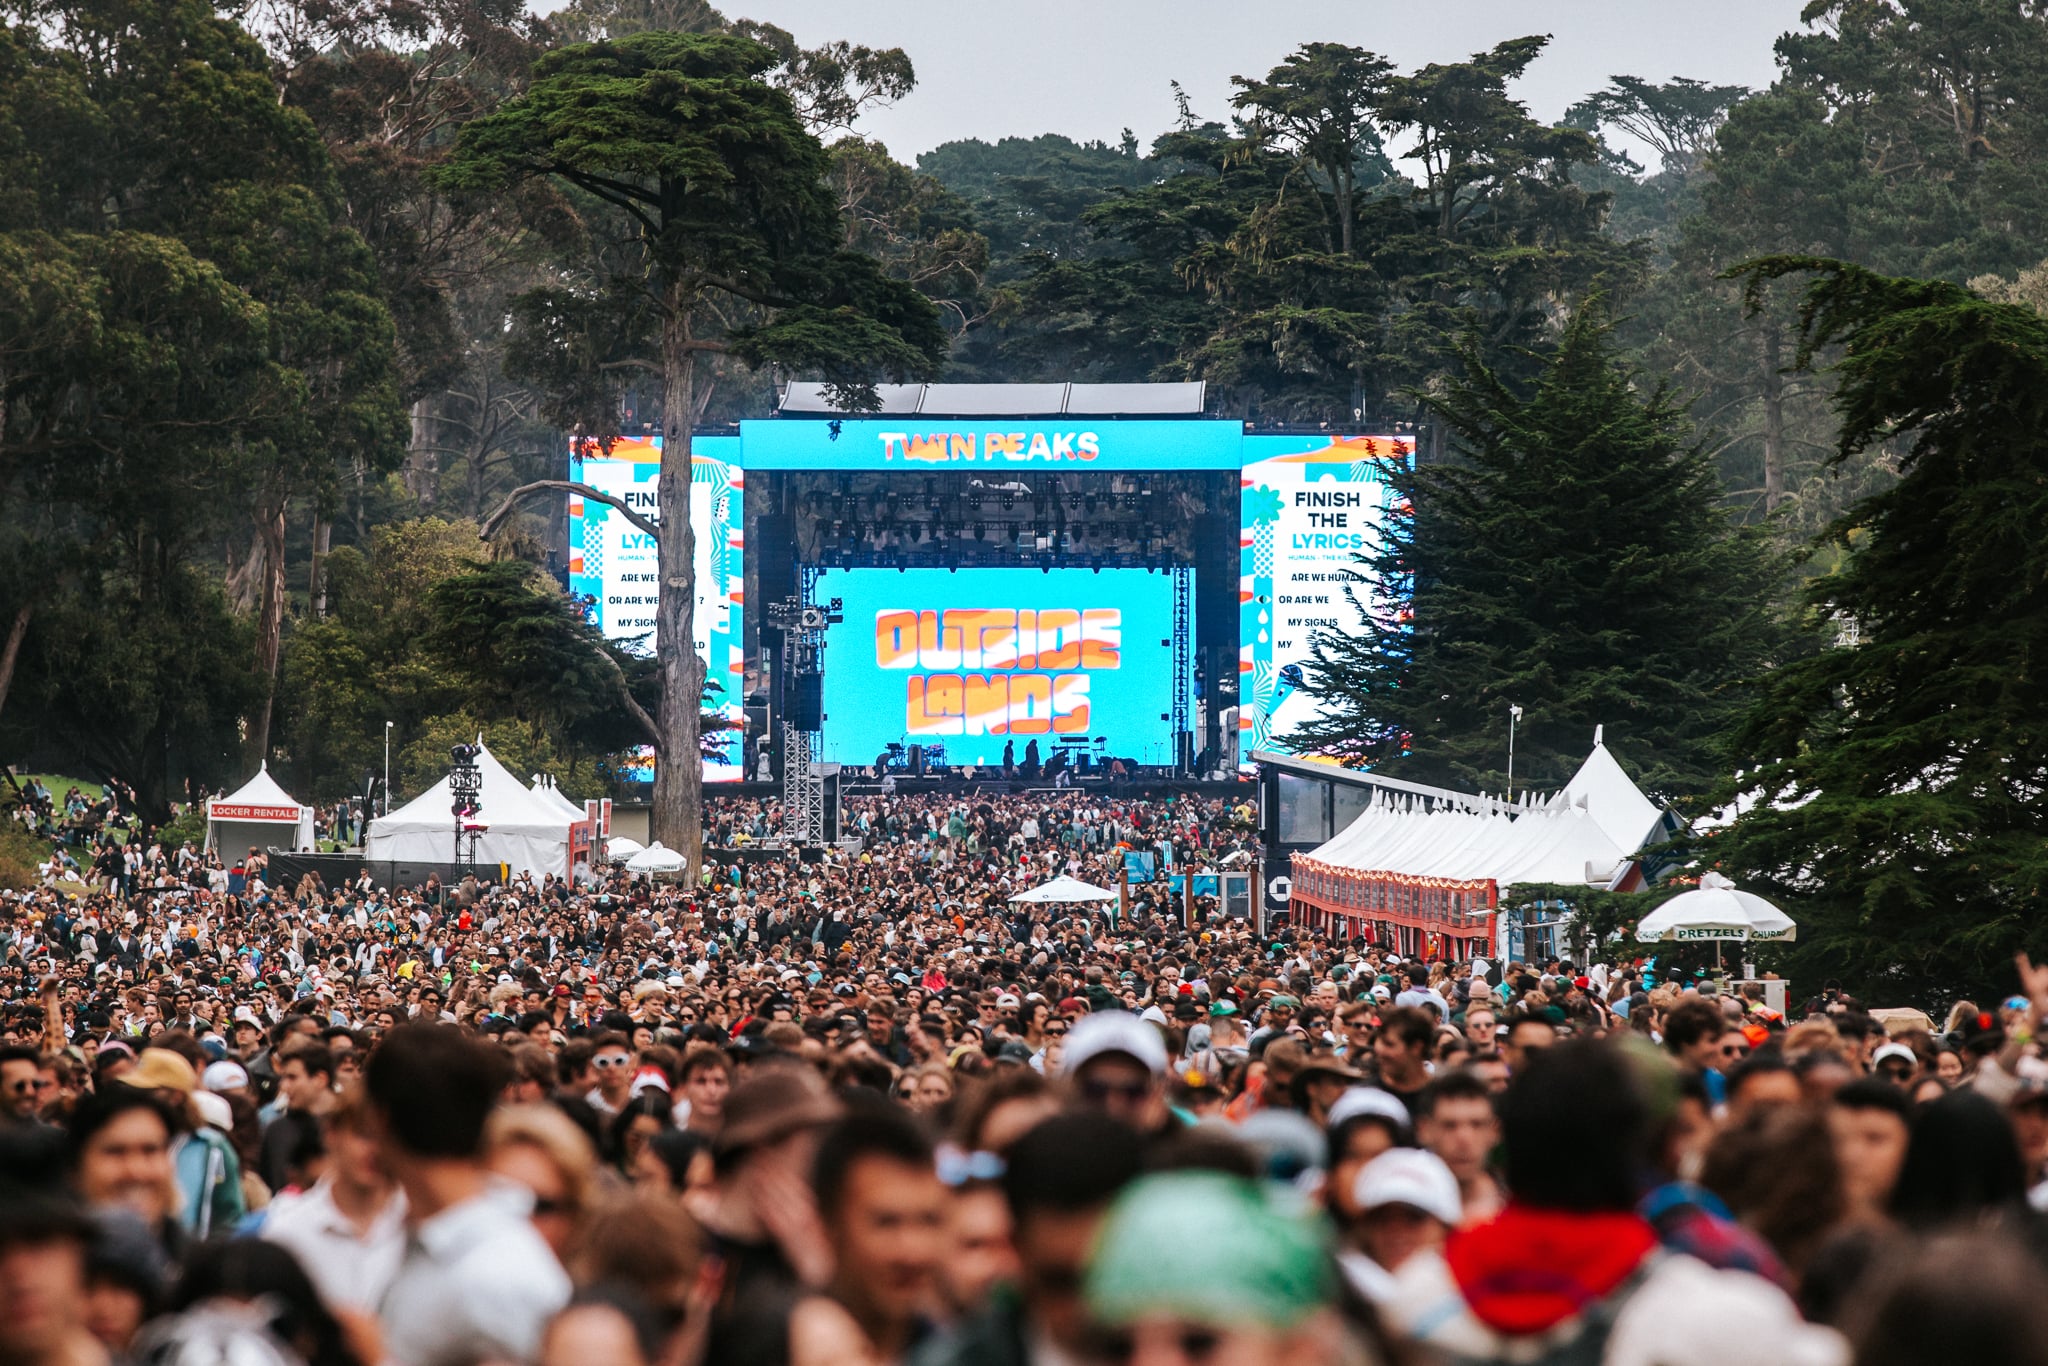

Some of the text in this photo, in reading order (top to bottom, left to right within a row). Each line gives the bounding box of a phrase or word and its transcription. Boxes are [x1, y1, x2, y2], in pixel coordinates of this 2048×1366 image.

[878, 432, 1099, 462] TWIN PEAKS
[1295, 492, 1361, 507] FINISH
[1308, 513, 1348, 527] THE
[621, 534, 657, 549] LYR
[1292, 533, 1363, 549] LYRICS
[621, 574, 639, 582] ARE
[641, 574, 655, 582] WE
[1291, 573, 1309, 582] ARE
[1312, 573, 1325, 582] WE
[608, 596, 622, 604] OR
[624, 596, 643, 604] ARE
[645, 596, 659, 604] WE
[1279, 595, 1293, 604] OR
[1295, 595, 1313, 604] ARE
[1315, 595, 1329, 604] WE
[618, 619, 632, 627] MY
[1288, 618, 1302, 626] MY
[1304, 618, 1327, 627] SIGN
[876, 609, 1121, 669] OUTSIDE
[1278, 640, 1292, 649] MY
[906, 674, 1090, 736] LANDS
[212, 807, 299, 818] LOCKER RENTALS
[1678, 928, 1745, 938] PRETZELS
